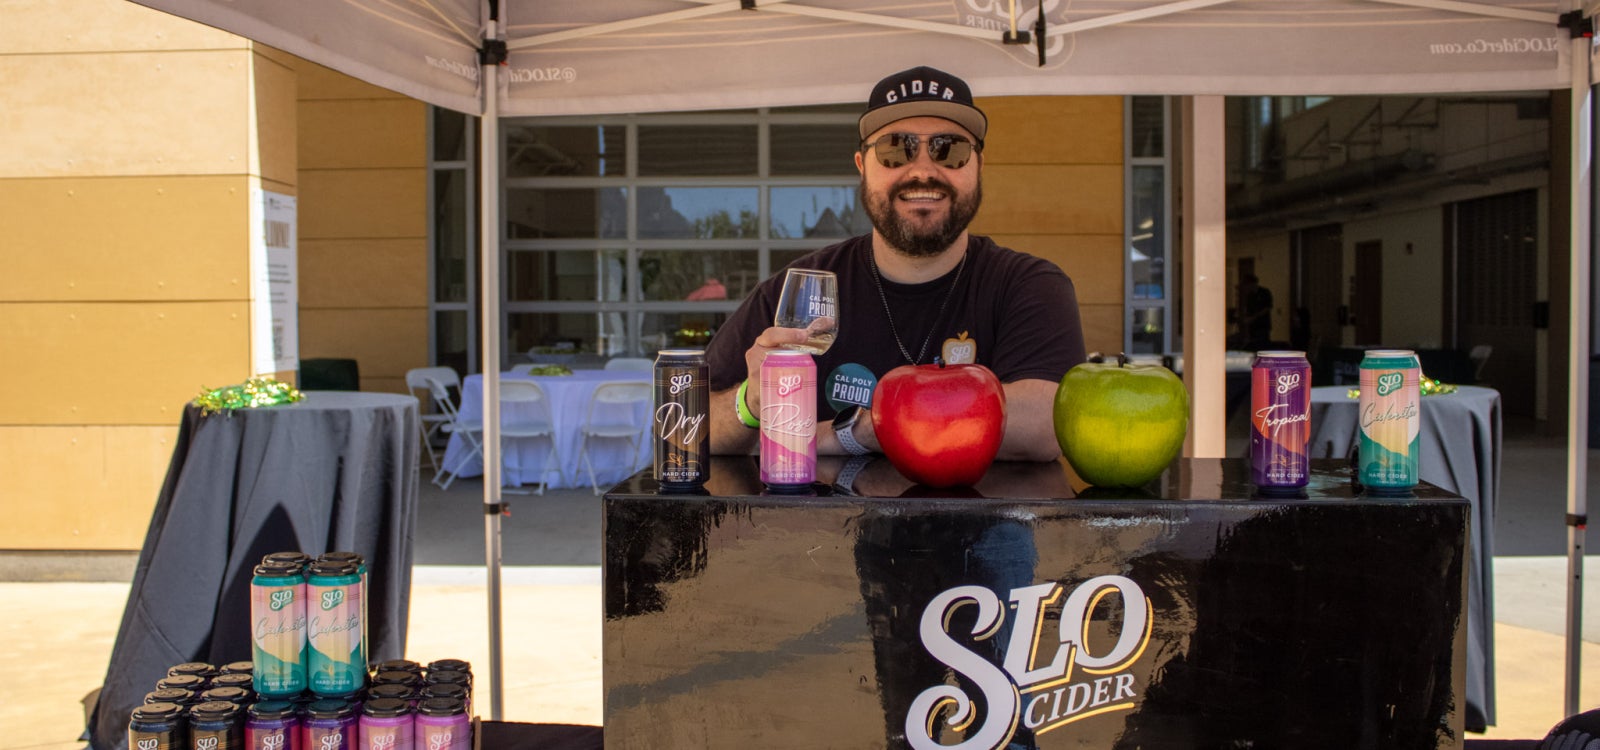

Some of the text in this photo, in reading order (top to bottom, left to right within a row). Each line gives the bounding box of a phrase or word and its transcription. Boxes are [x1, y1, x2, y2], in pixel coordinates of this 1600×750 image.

[886, 79, 954, 103] CIDER
[809, 301, 835, 317] PROUD
[670, 374, 692, 394] SLO
[778, 375, 801, 395] SLO
[835, 374, 873, 386] CAL POLY
[1277, 373, 1299, 394] SLO
[1378, 374, 1401, 394] SLO
[832, 382, 871, 404] PROUD
[656, 402, 706, 445] Dry
[1255, 400, 1311, 437] Tropical
[271, 589, 293, 610] SLO
[322, 589, 343, 609] SLO
[905, 575, 1153, 750] SLO
[1023, 673, 1137, 729] CIDER
[137, 738, 159, 750] SLO
[196, 737, 218, 750] SLO
[262, 733, 285, 750] SLO
[321, 733, 343, 750] SLO
[373, 733, 395, 750] SLO
[430, 733, 452, 750] SLO
